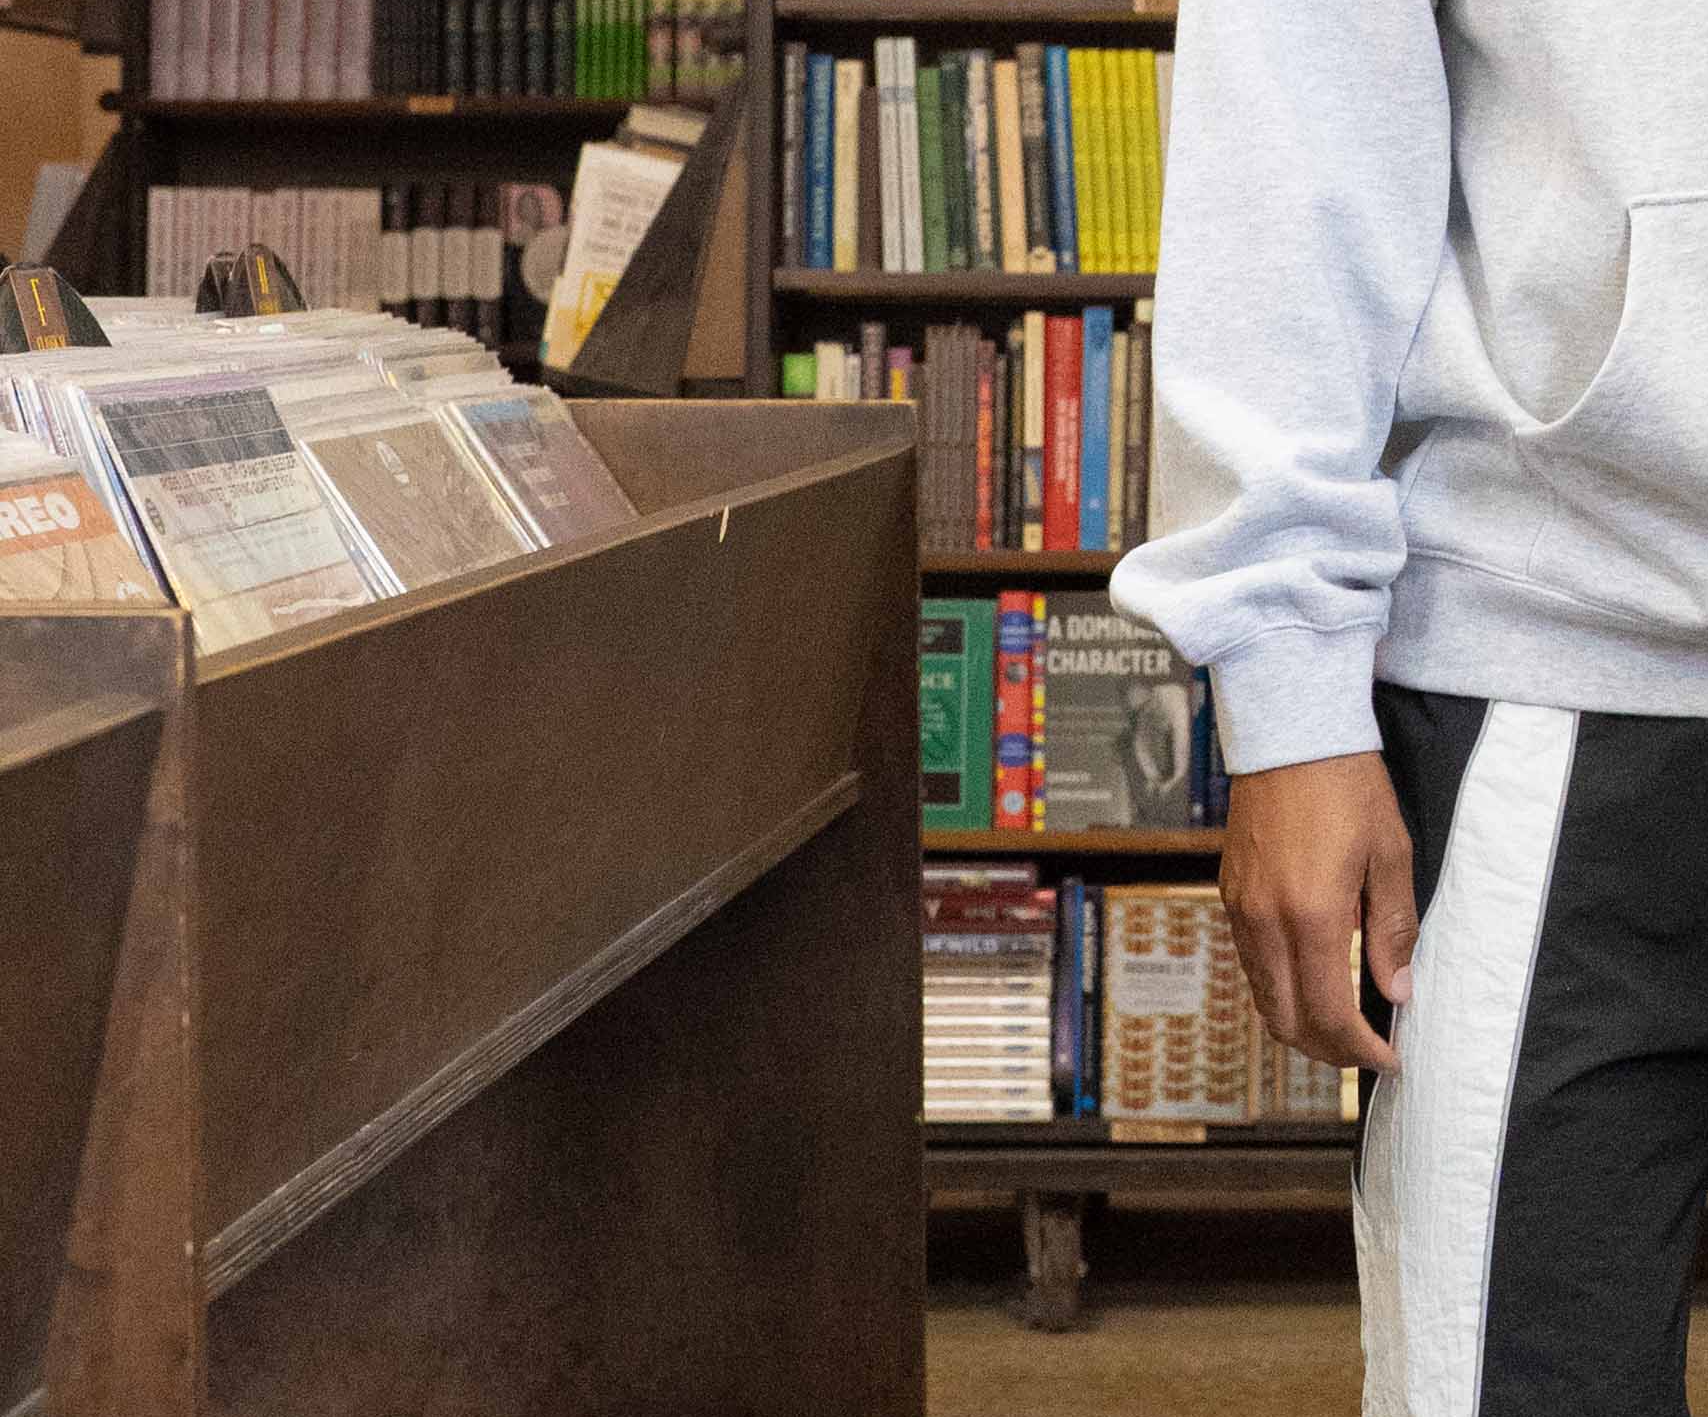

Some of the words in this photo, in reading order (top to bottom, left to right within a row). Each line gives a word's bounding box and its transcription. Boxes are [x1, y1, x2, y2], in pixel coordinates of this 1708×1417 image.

[1046, 614, 1062, 640] A
[1065, 614, 1163, 641] DOMIN
[1047, 648, 1171, 675] CHARACTER
